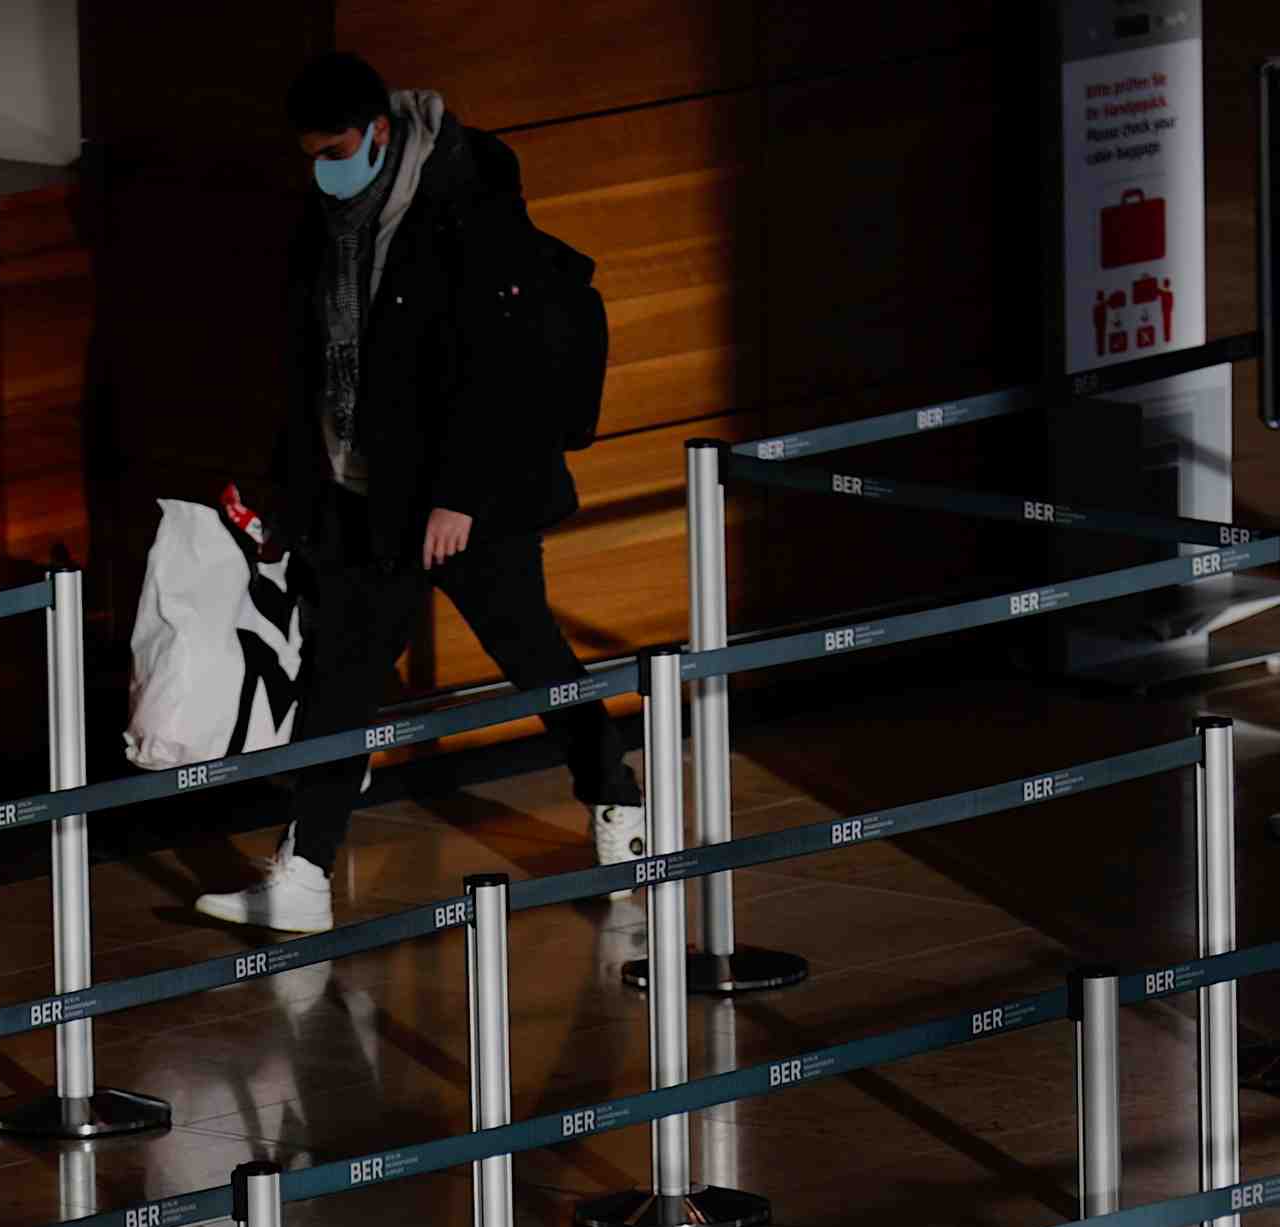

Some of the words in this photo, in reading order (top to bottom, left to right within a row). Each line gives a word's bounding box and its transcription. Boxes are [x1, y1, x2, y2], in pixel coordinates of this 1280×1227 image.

[917, 408, 943, 429] BER
[757, 441, 784, 460] BER
[832, 473, 862, 496] BER
[1024, 502, 1055, 524] BER
[1220, 527, 1250, 546] BER
[1192, 554, 1221, 576] BER
[1010, 592, 1039, 615] BER
[825, 628, 855, 652] BER
[549, 681, 578, 705] BER
[366, 724, 395, 749] BER
[177, 764, 208, 789] BER
[1023, 777, 1052, 801] BER
[832, 820, 862, 844] BER
[635, 858, 667, 884] BER
[434, 903, 466, 929] BER
[235, 953, 268, 979] BER
[1145, 970, 1174, 995] BER
[30, 1000, 63, 1026] BER
[971, 1007, 1003, 1034] BER
[769, 1059, 801, 1088] BER
[562, 1111, 594, 1136] BER
[350, 1157, 383, 1184] BER
[1231, 1183, 1262, 1208] BER
